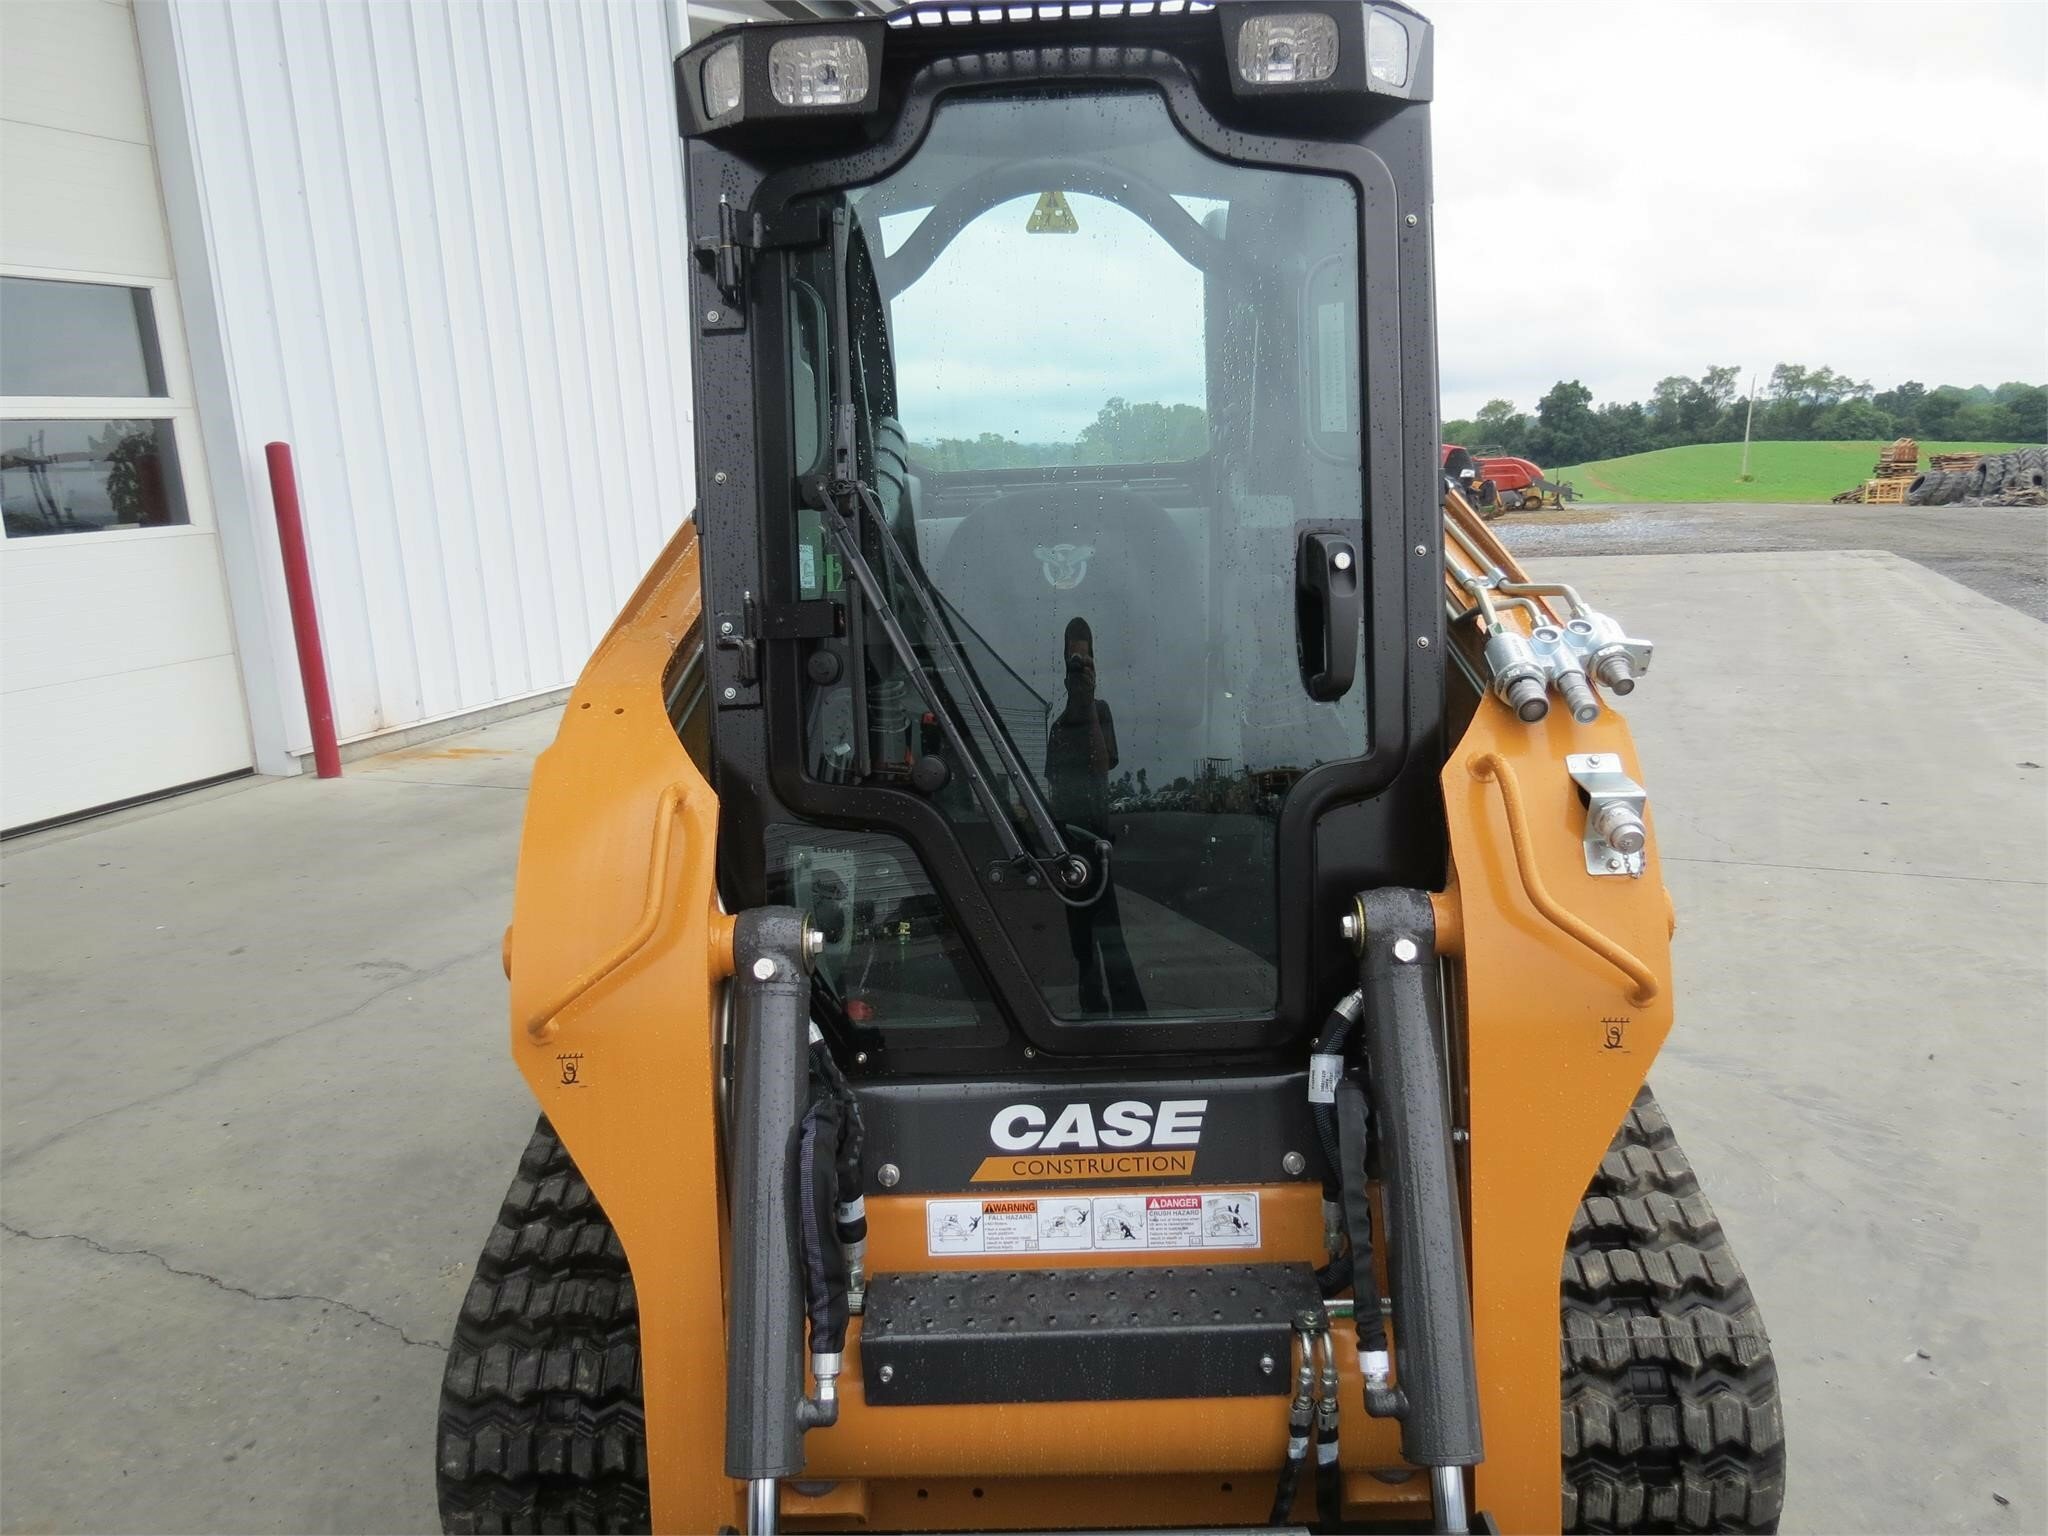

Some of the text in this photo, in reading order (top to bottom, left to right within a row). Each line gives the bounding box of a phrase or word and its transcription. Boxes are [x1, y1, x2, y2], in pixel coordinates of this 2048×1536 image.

[990, 1100, 1207, 1150] CASE
[1012, 1156, 1187, 1177] CONSTRUCTION
[993, 1203, 1035, 1212] WARNING
[1160, 1198, 1198, 1208] DANGER
